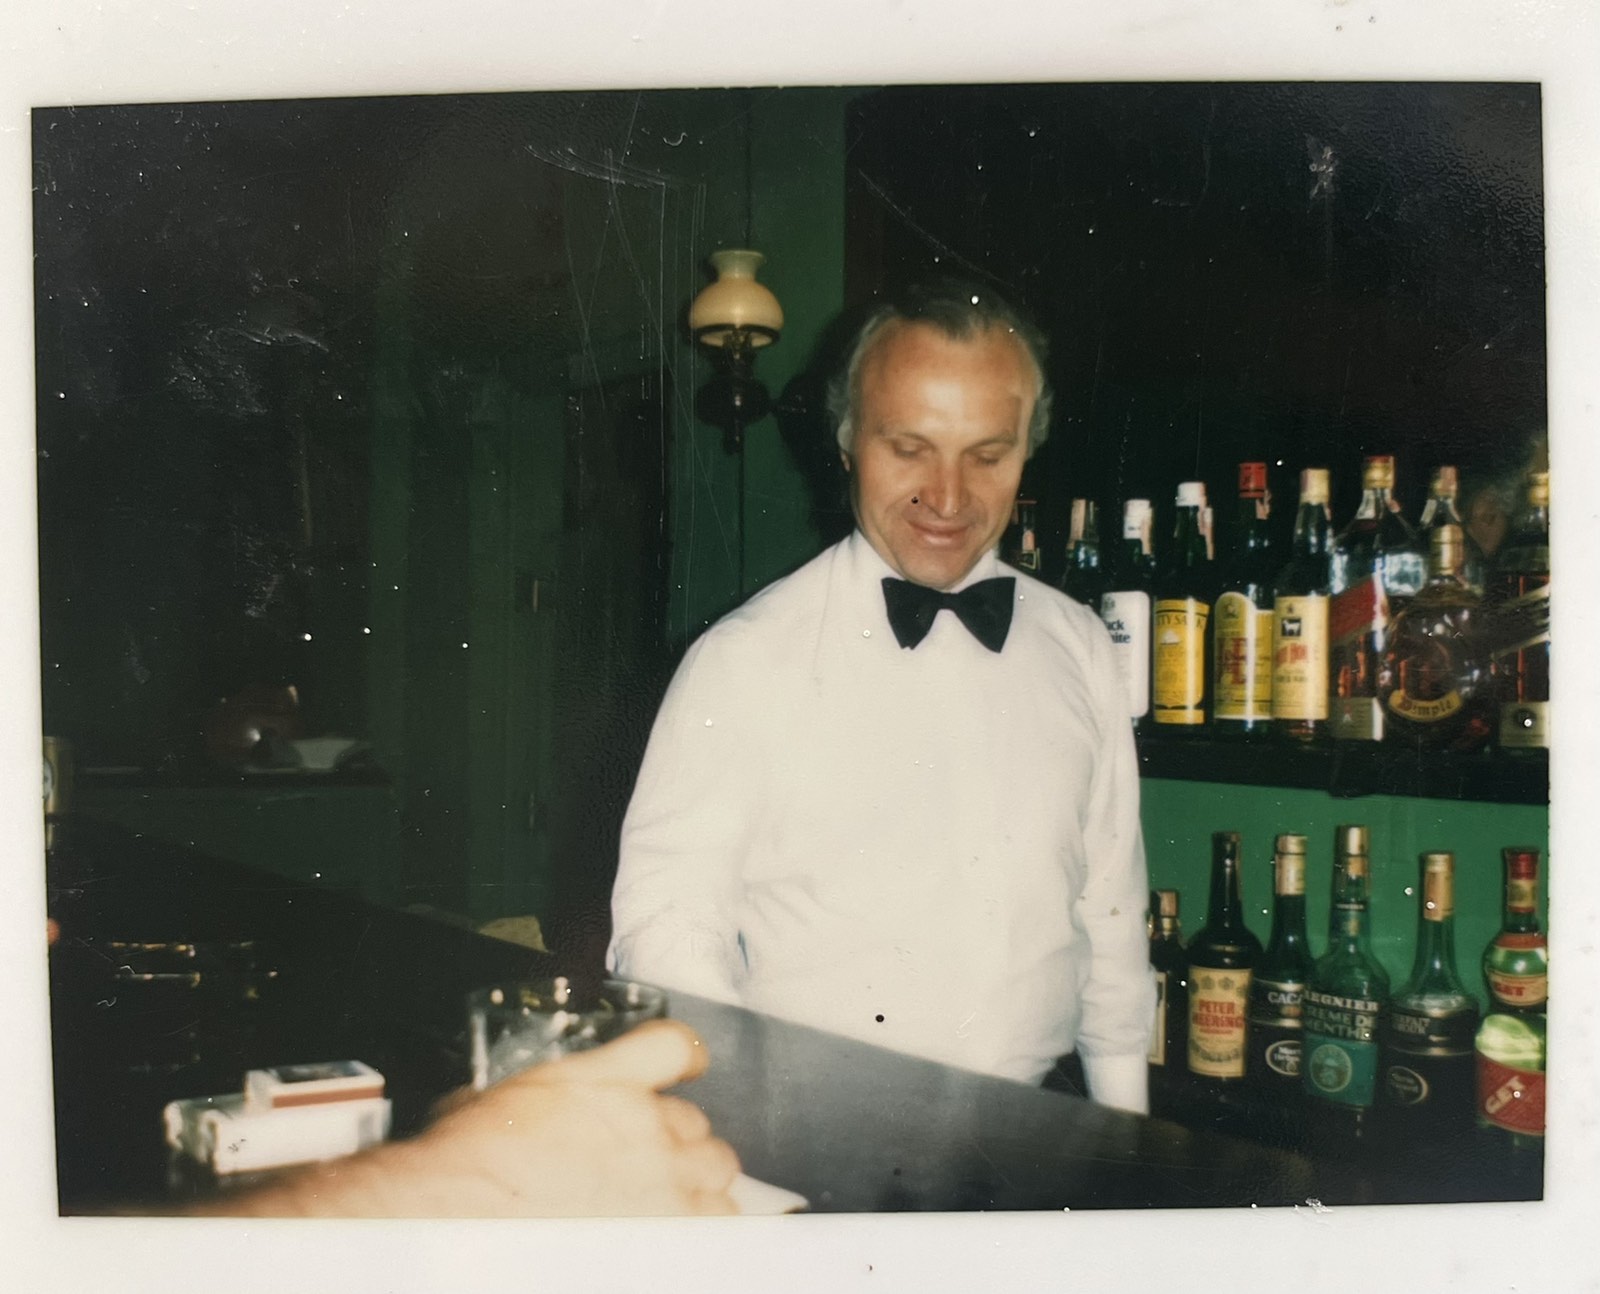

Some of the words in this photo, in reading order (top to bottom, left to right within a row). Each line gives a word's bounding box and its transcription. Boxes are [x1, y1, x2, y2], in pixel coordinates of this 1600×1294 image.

[1107, 620, 1124, 631] ack
[1199, 1000, 1235, 1014] PETER
[1307, 1006, 1353, 1023] REME
